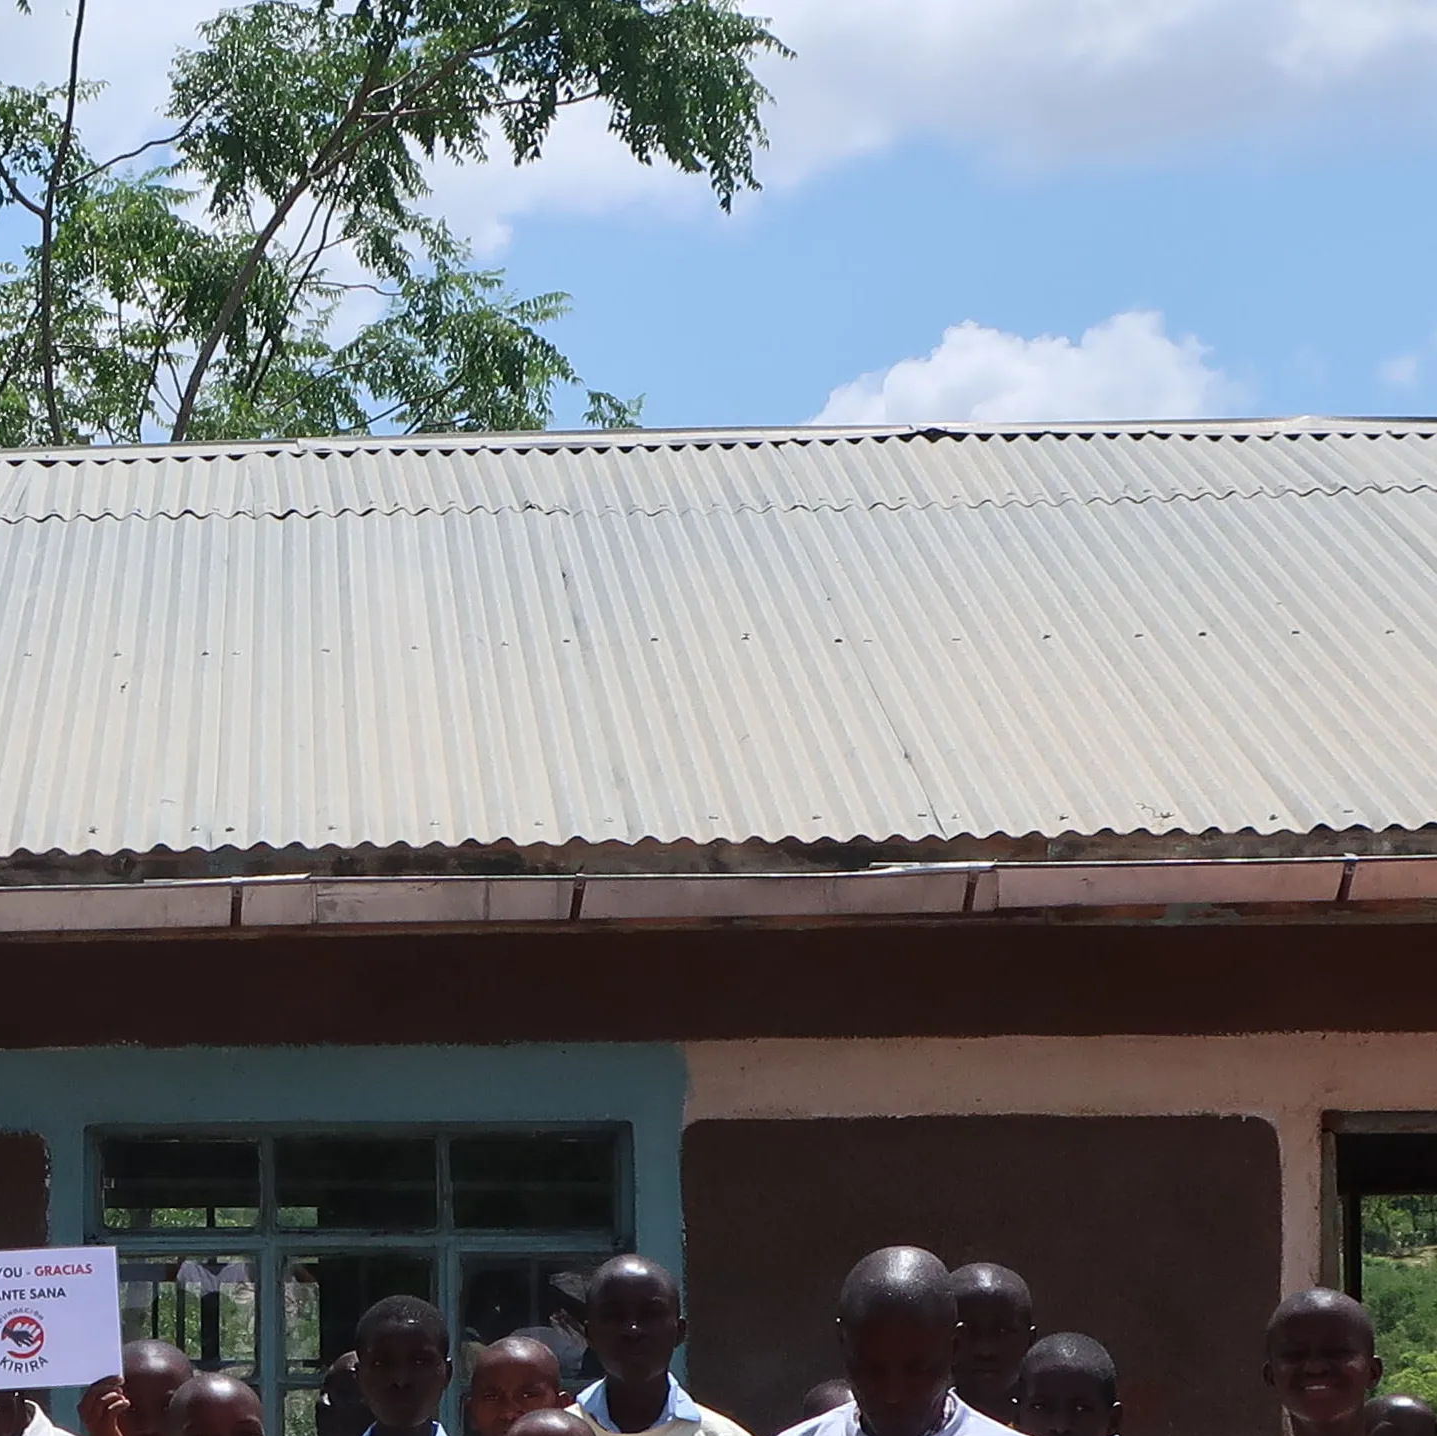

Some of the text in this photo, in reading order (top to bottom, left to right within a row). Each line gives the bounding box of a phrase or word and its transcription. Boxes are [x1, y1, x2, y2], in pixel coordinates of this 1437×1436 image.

[34, 1263, 93, 1277] GRACIAS
[29, 1287, 67, 1299] SANA
[0, 1356, 49, 1374] KIRIRA
